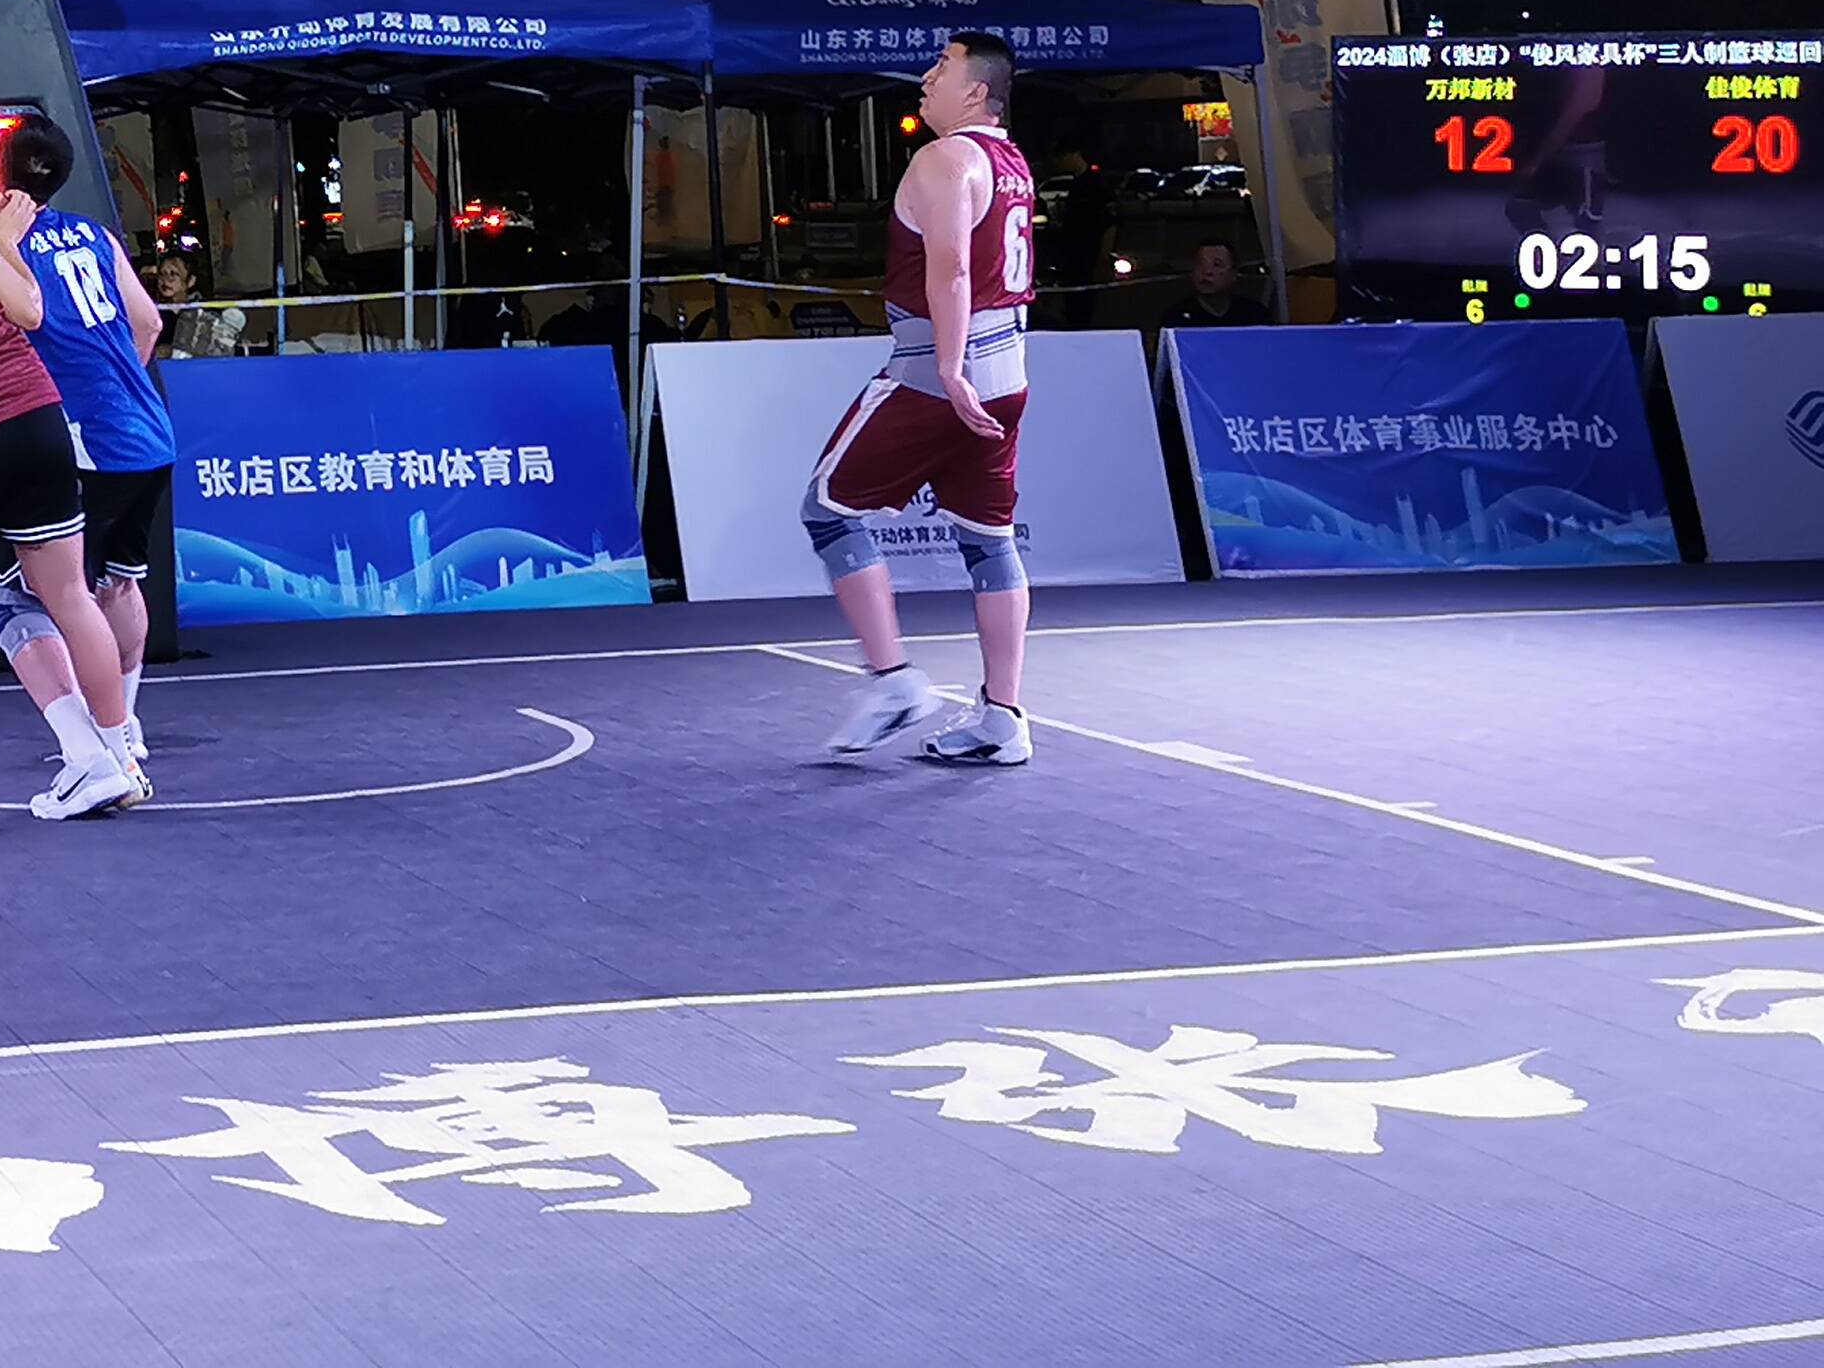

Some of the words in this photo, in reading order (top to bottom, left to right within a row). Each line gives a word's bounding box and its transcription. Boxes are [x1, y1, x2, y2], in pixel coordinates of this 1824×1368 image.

[390, 32, 488, 48] DEVELOPMENT
[800, 25, 1109, 50] 山东齐动体育有限公司
[1425, 76, 1518, 102] 万邦新材
[1704, 75, 1801, 101] 佳俊体育
[1434, 114, 1514, 173] 12
[1710, 114, 1800, 174] 20
[1518, 232, 1711, 292] 02:15
[1466, 298, 1485, 324] 6
[1223, 414, 1620, 455] 张店区体育事业服务中心
[195, 445, 555, 498] 张店区教育和体育局
